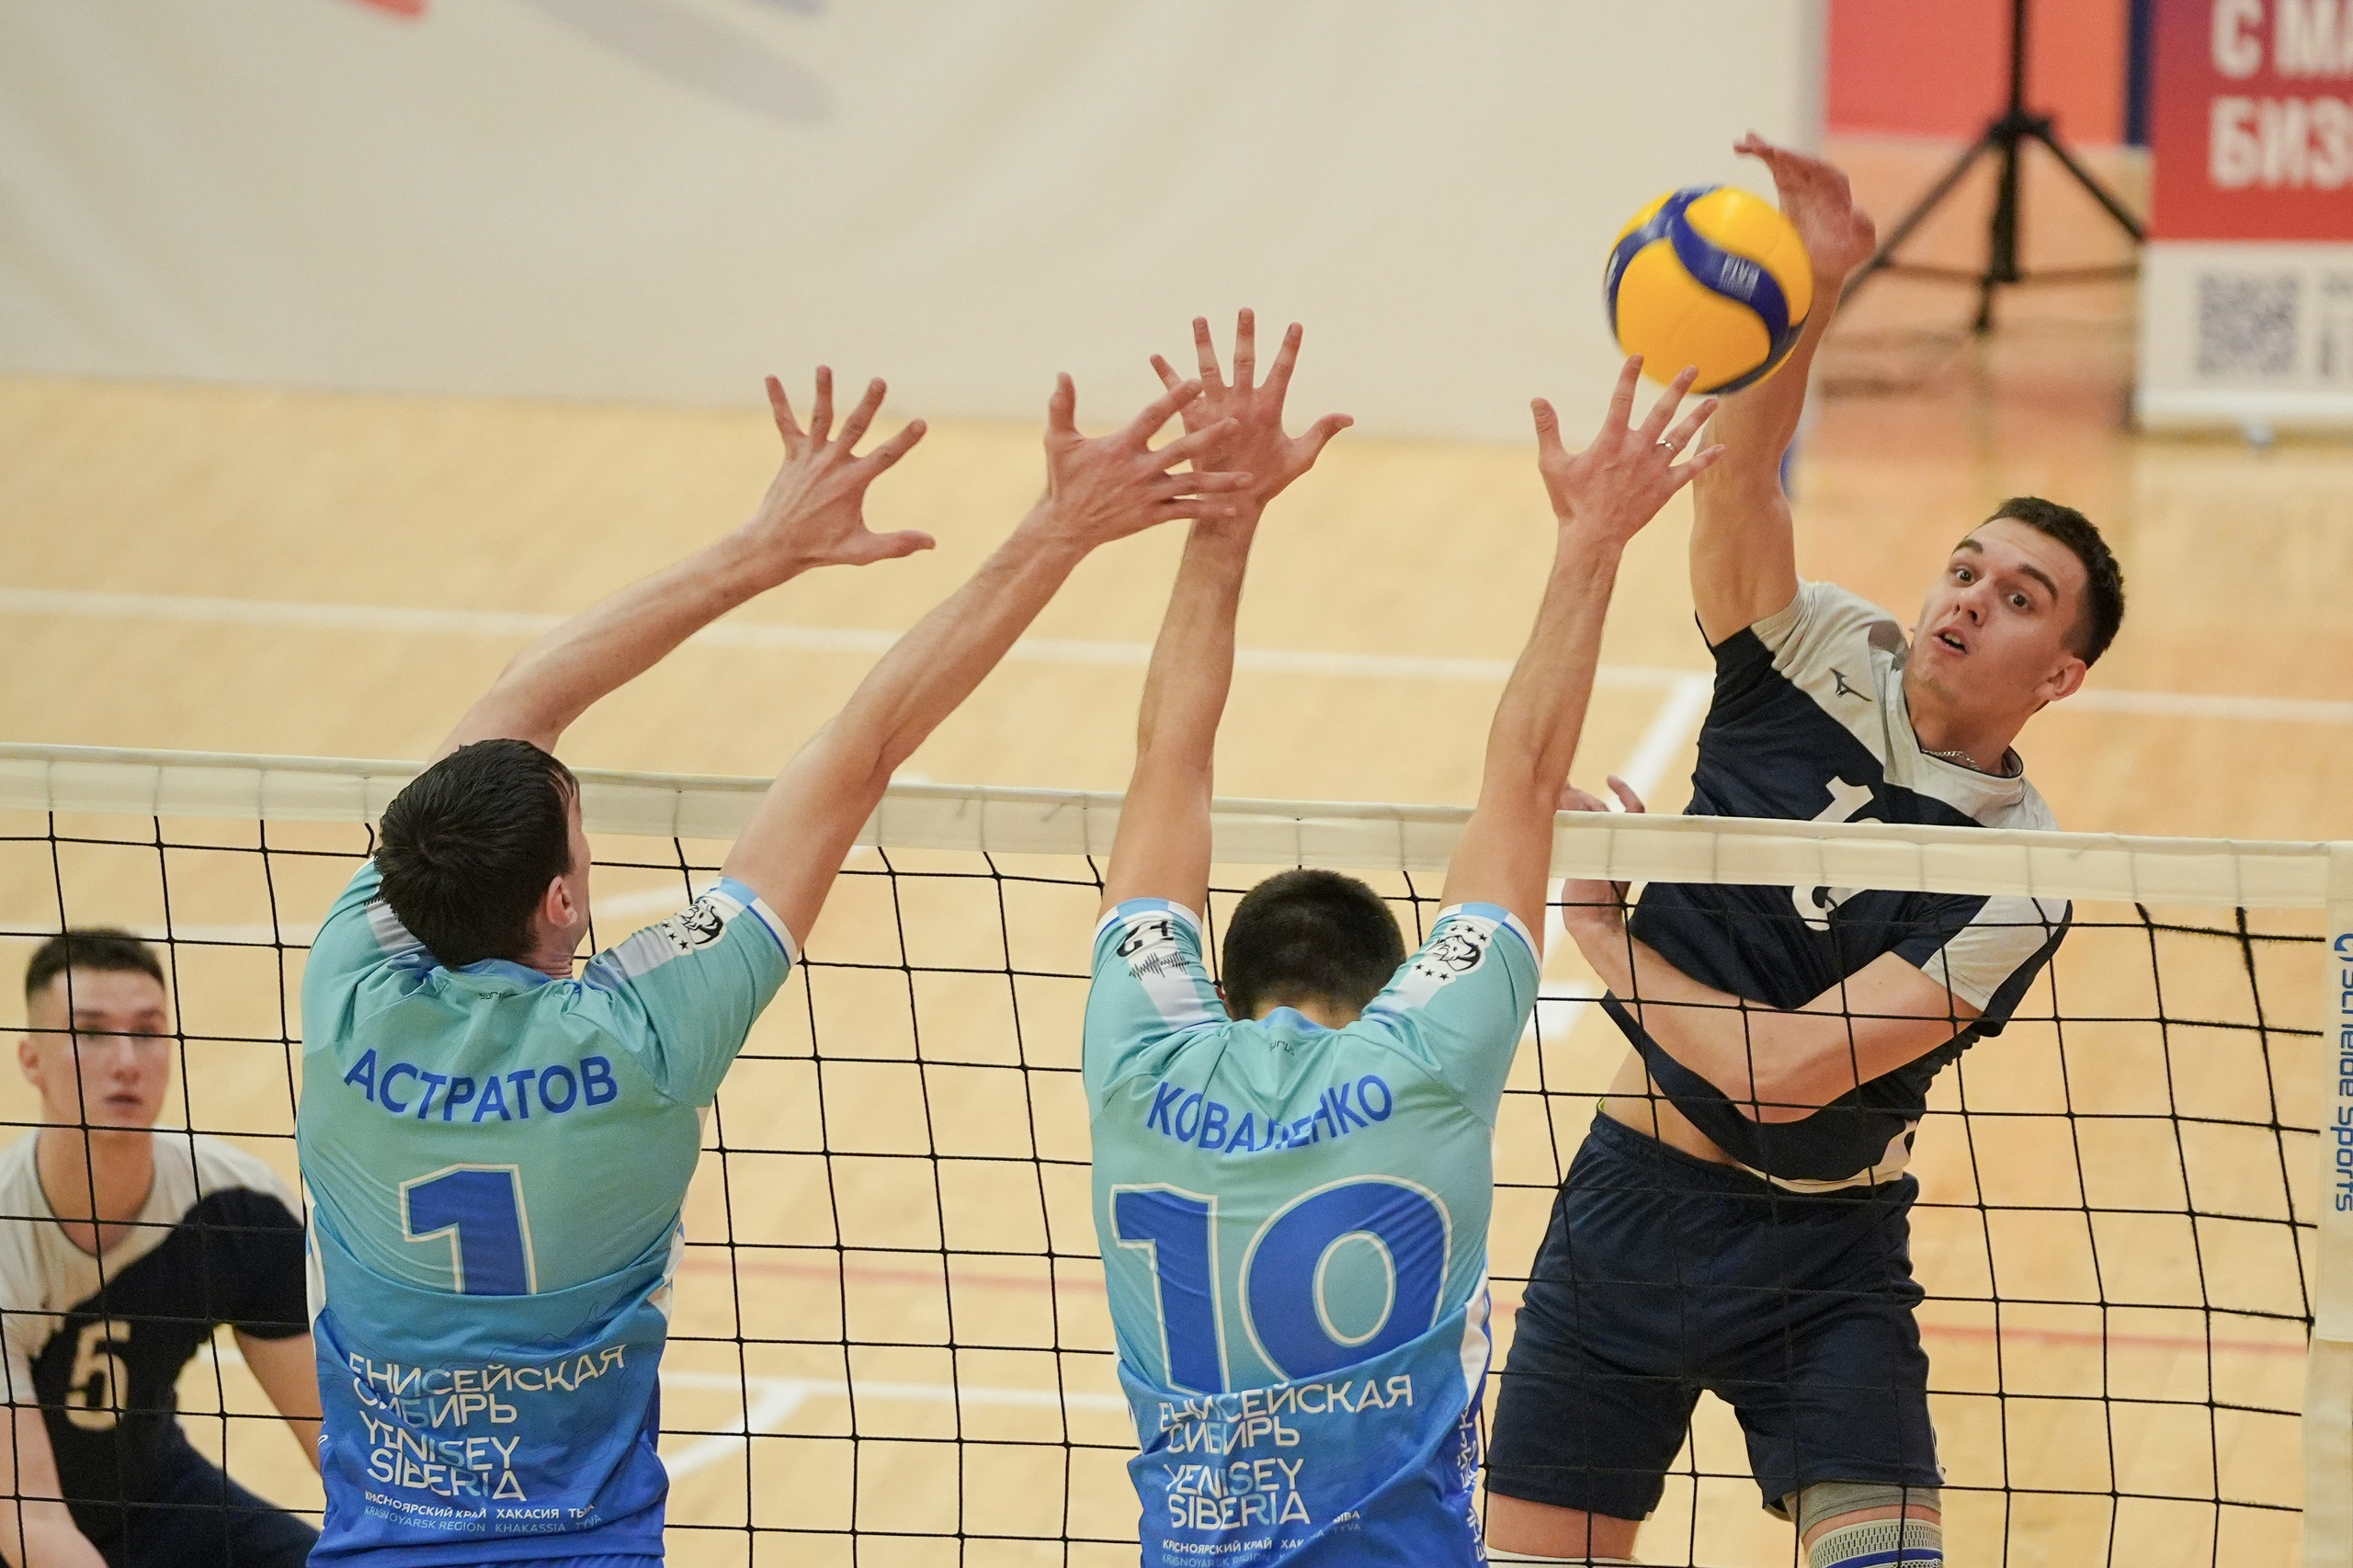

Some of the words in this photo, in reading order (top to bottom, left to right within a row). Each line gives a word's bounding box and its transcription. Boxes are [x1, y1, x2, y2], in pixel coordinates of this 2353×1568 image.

[2273, 0, 2353, 75] М
[343, 1047, 619, 1123] АСТРАТОВ
[1145, 1074, 1393, 1154] КОВАЛЕНКО
[399, 1163, 538, 1296] 1
[1110, 1174, 1453, 1396] 10
[64, 1319, 131, 1431] 5
[349, 1344, 626, 1397] ЕНИСЕЙСКАЯ
[1166, 1416, 1301, 1456] СИБИРЬ
[367, 1448, 527, 1502] SIBERIA
[1163, 1458, 1304, 1499] YENISEY
[439, 1520, 485, 1532] REGION
[494, 1522, 566, 1534] KHAKASSIA
[496, 1508, 560, 1519] ХАКАСИЯ
[1167, 1491, 1311, 1530] SIBERIA
[1162, 1539, 1242, 1555] КРСНОЯРСКИЙ
